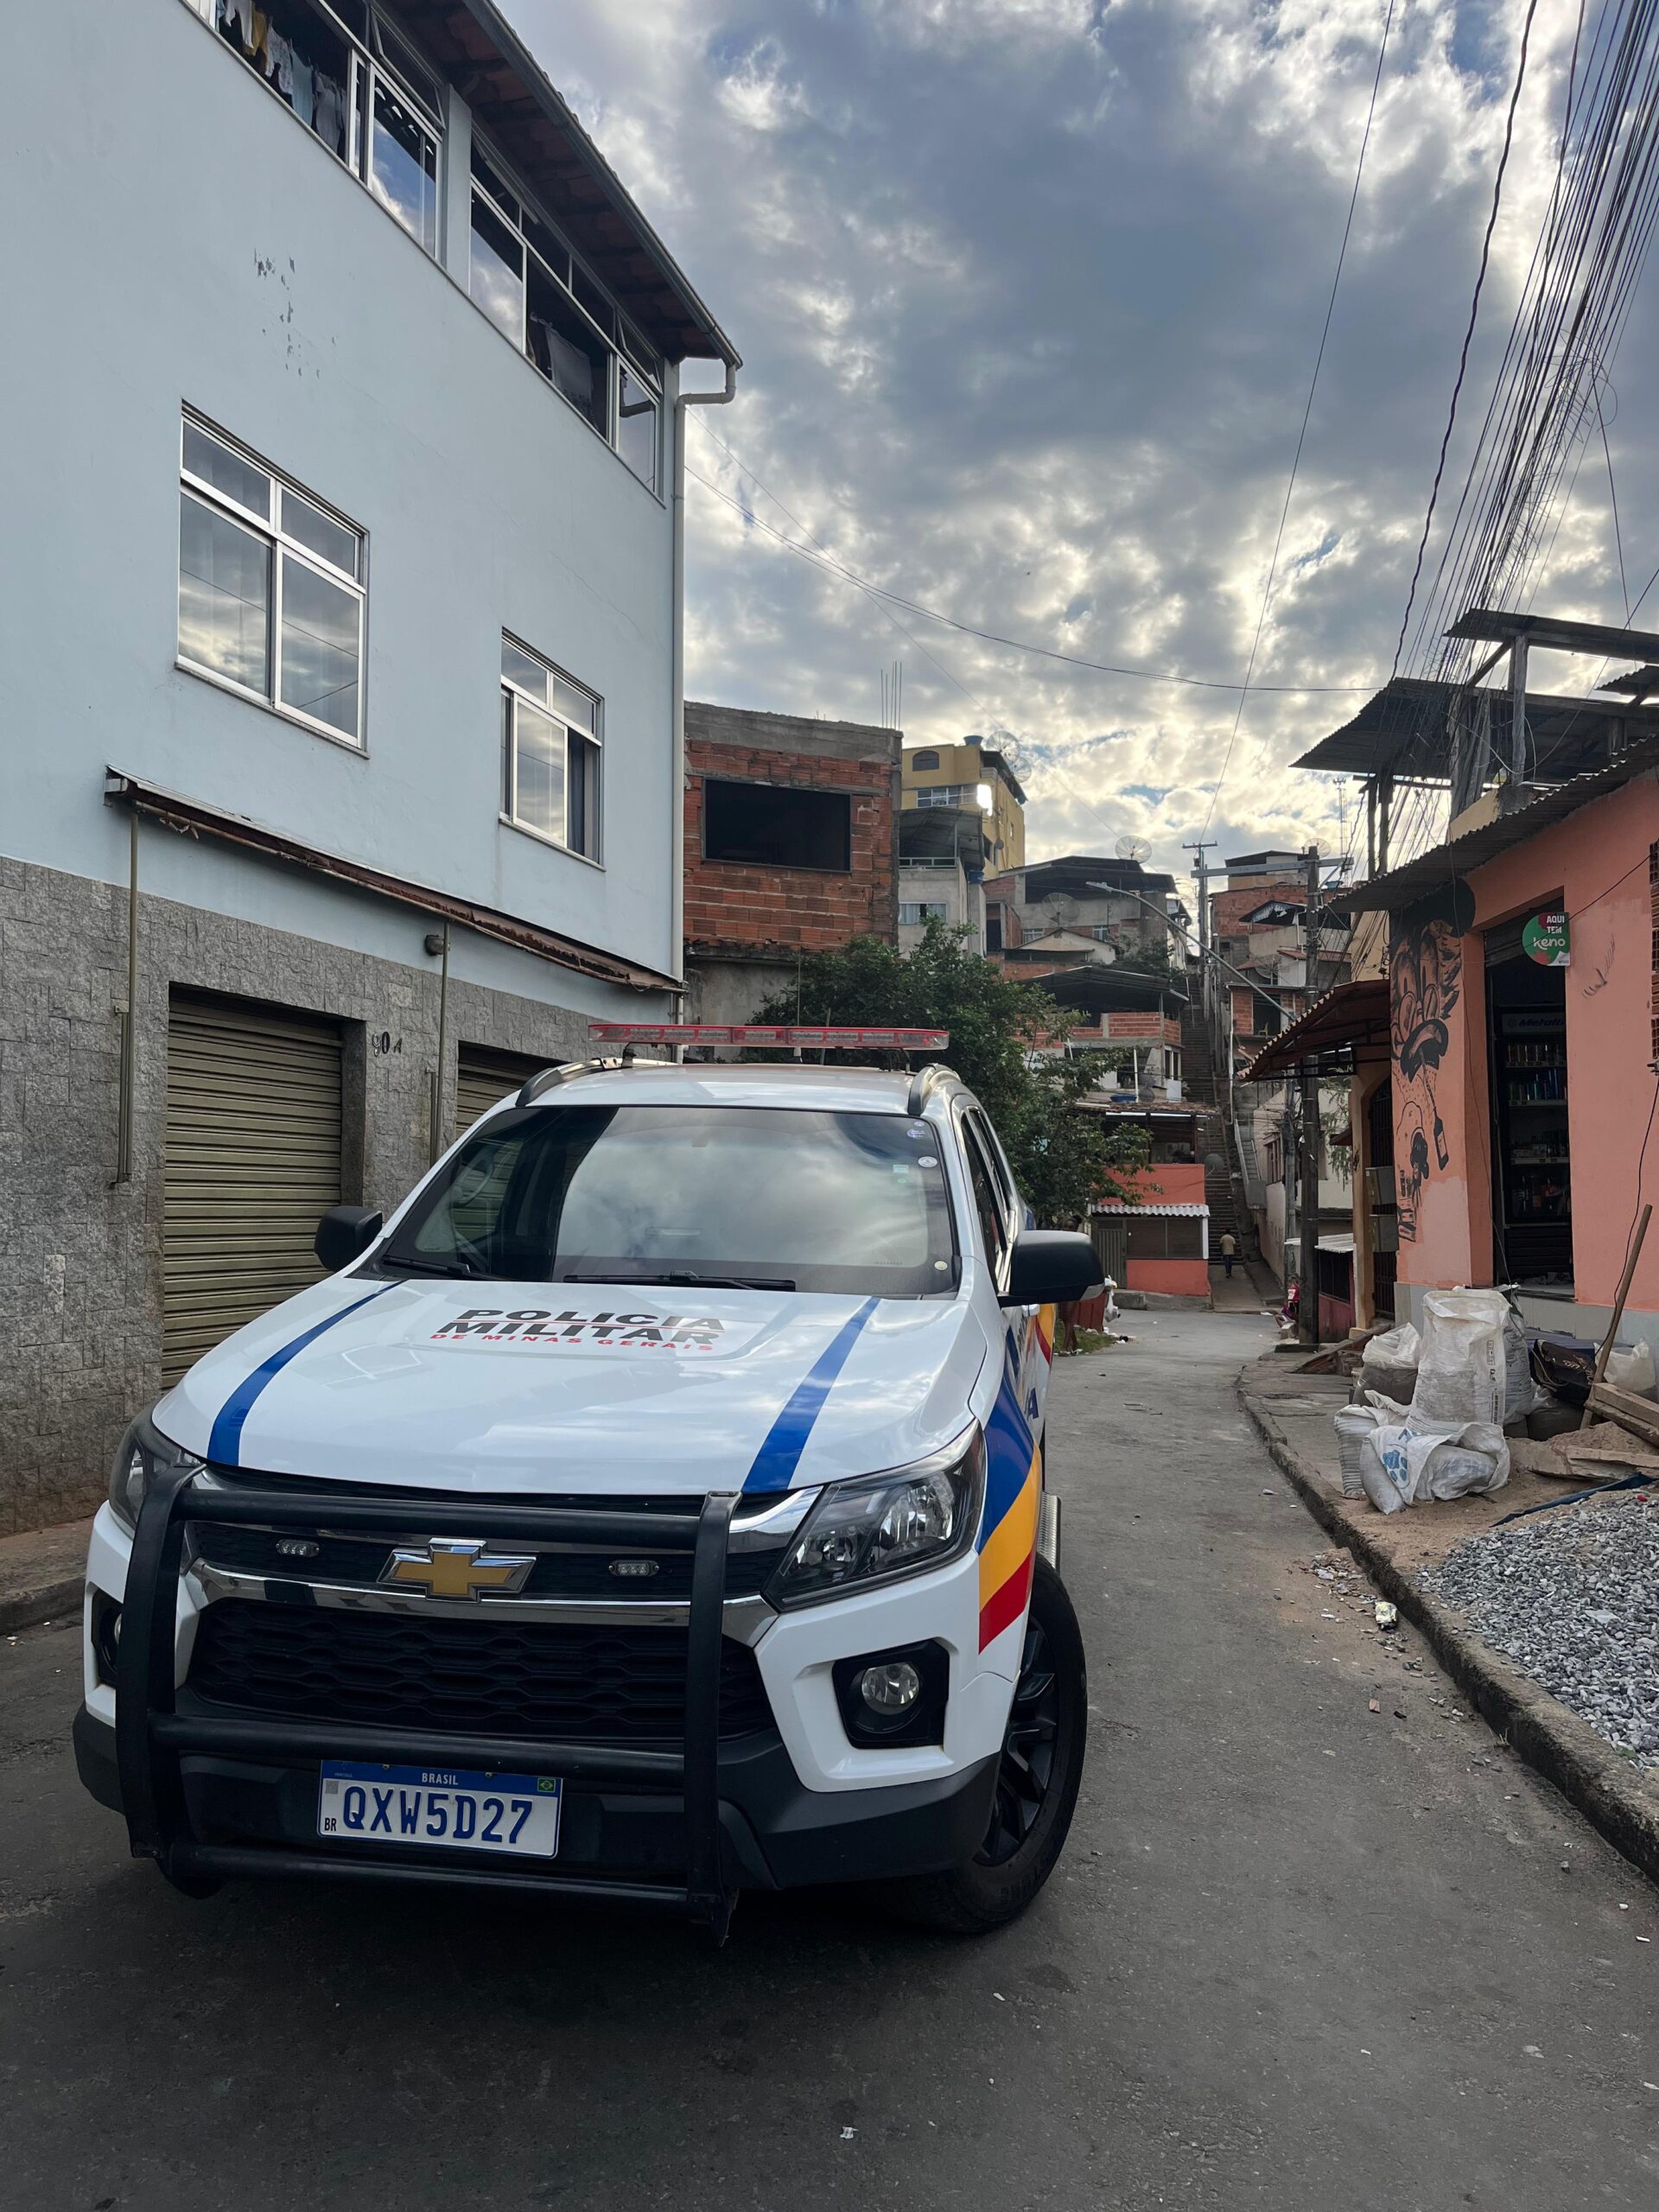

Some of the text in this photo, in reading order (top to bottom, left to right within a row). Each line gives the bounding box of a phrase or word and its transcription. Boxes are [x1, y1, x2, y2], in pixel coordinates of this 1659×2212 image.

[1547, 915, 1565, 924] AQUI
[1533, 937, 1566, 950] keno
[436, 1322, 720, 1344] MILITAR
[482, 1335, 582, 1344] MINAS
[597, 1339, 714, 1351] GERAIS
[422, 1772, 459, 1786] BRASIL
[343, 1786, 533, 1844] QXW5D27
[324, 1817, 337, 1832] BR
